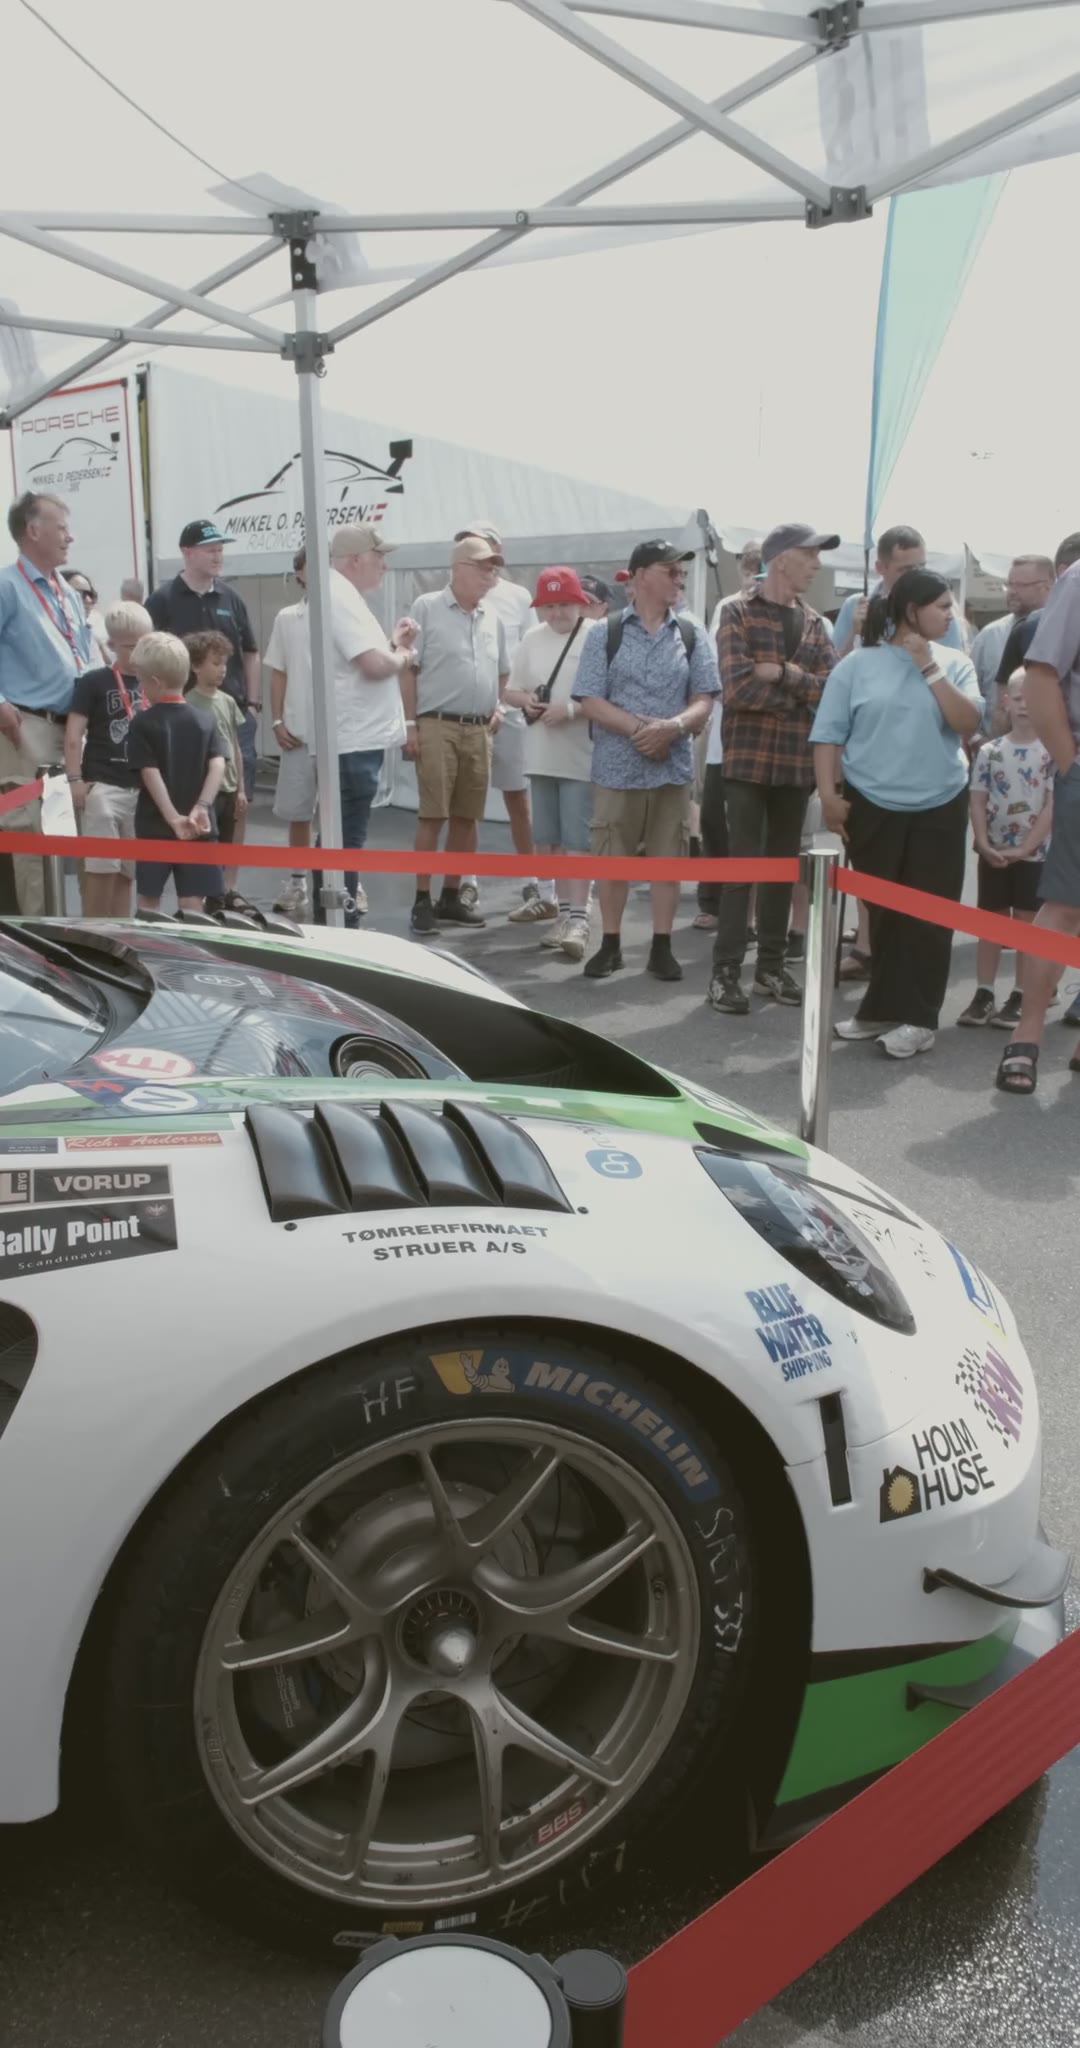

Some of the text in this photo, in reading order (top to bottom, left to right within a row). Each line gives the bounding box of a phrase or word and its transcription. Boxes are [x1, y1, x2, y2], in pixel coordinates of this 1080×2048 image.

[22, 406, 119, 434] PORSCHE
[224, 515, 272, 534] MIKKEL
[277, 513, 289, 531] O.
[247, 532, 298, 551] RACING
[65, 1134, 220, 1148] Rich. Andersen
[17, 1172, 28, 1191] BYG
[53, 1173, 152, 1192] VORUP
[0, 1215, 141, 1256] ally Point
[342, 1222, 549, 1244] TØMRERFIRMAET
[18, 1249, 113, 1270] Scandinavia
[373, 1240, 527, 1261] STRUER A/S
[745, 1283, 804, 1323] BLUE
[755, 1313, 832, 1363] WATER
[781, 1349, 832, 1382] SHIPPING
[523, 1361, 710, 1488] MICHELIN
[912, 1417, 978, 1470] HOLM
[922, 1453, 996, 1511] HUSE
[537, 1800, 584, 1843] BBS
